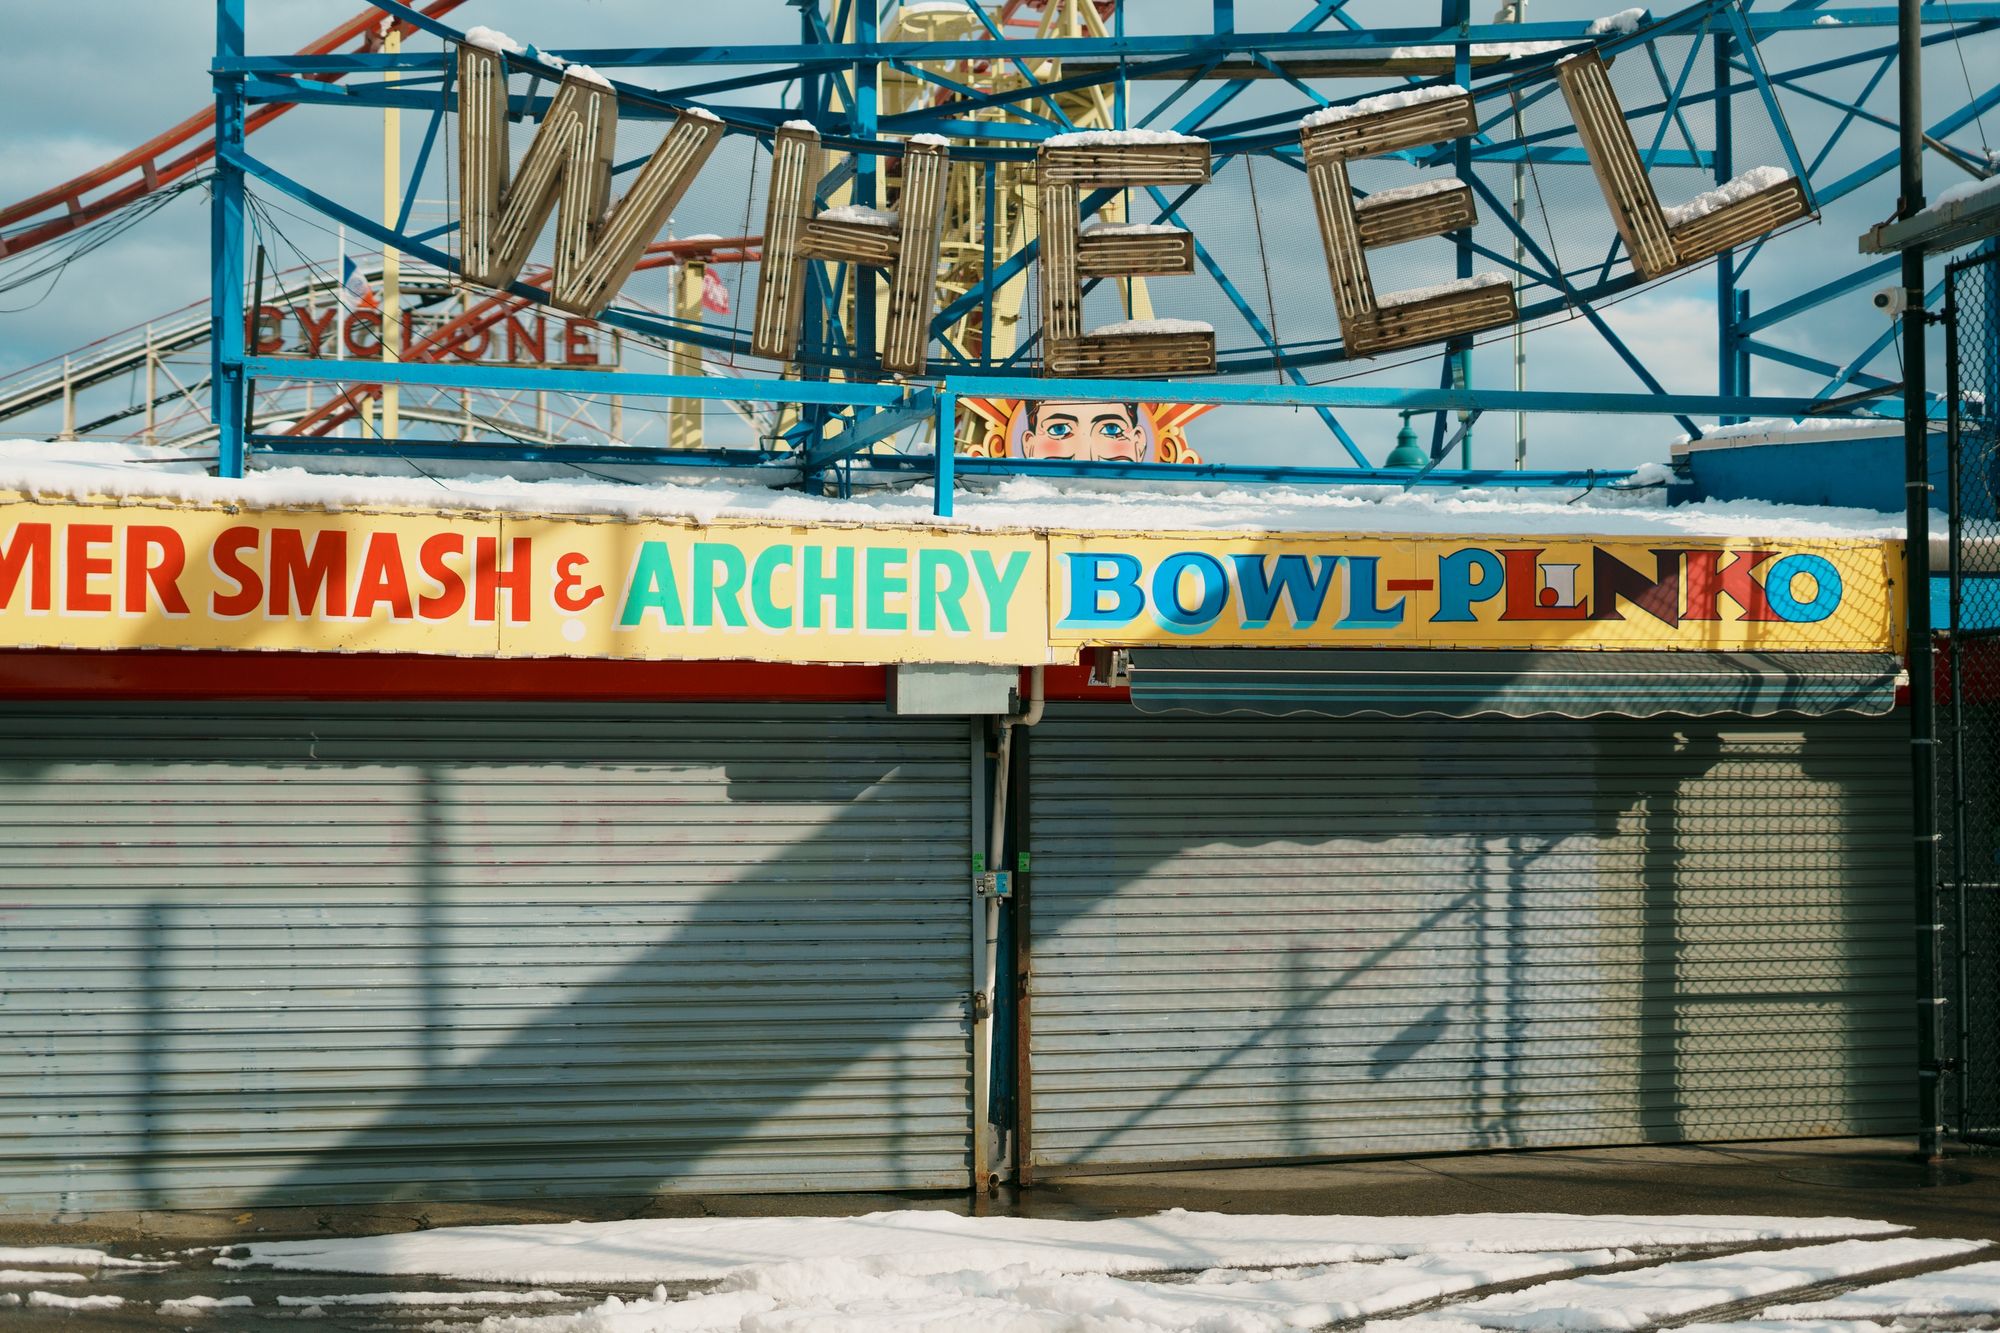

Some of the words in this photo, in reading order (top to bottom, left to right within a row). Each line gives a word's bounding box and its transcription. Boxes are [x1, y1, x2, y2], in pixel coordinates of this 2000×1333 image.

[458, 43, 1811, 378] WHEEL
[211, 526, 532, 623] SMASH
[552, 551, 606, 612] &
[617, 541, 1032, 634] ARCHERY
